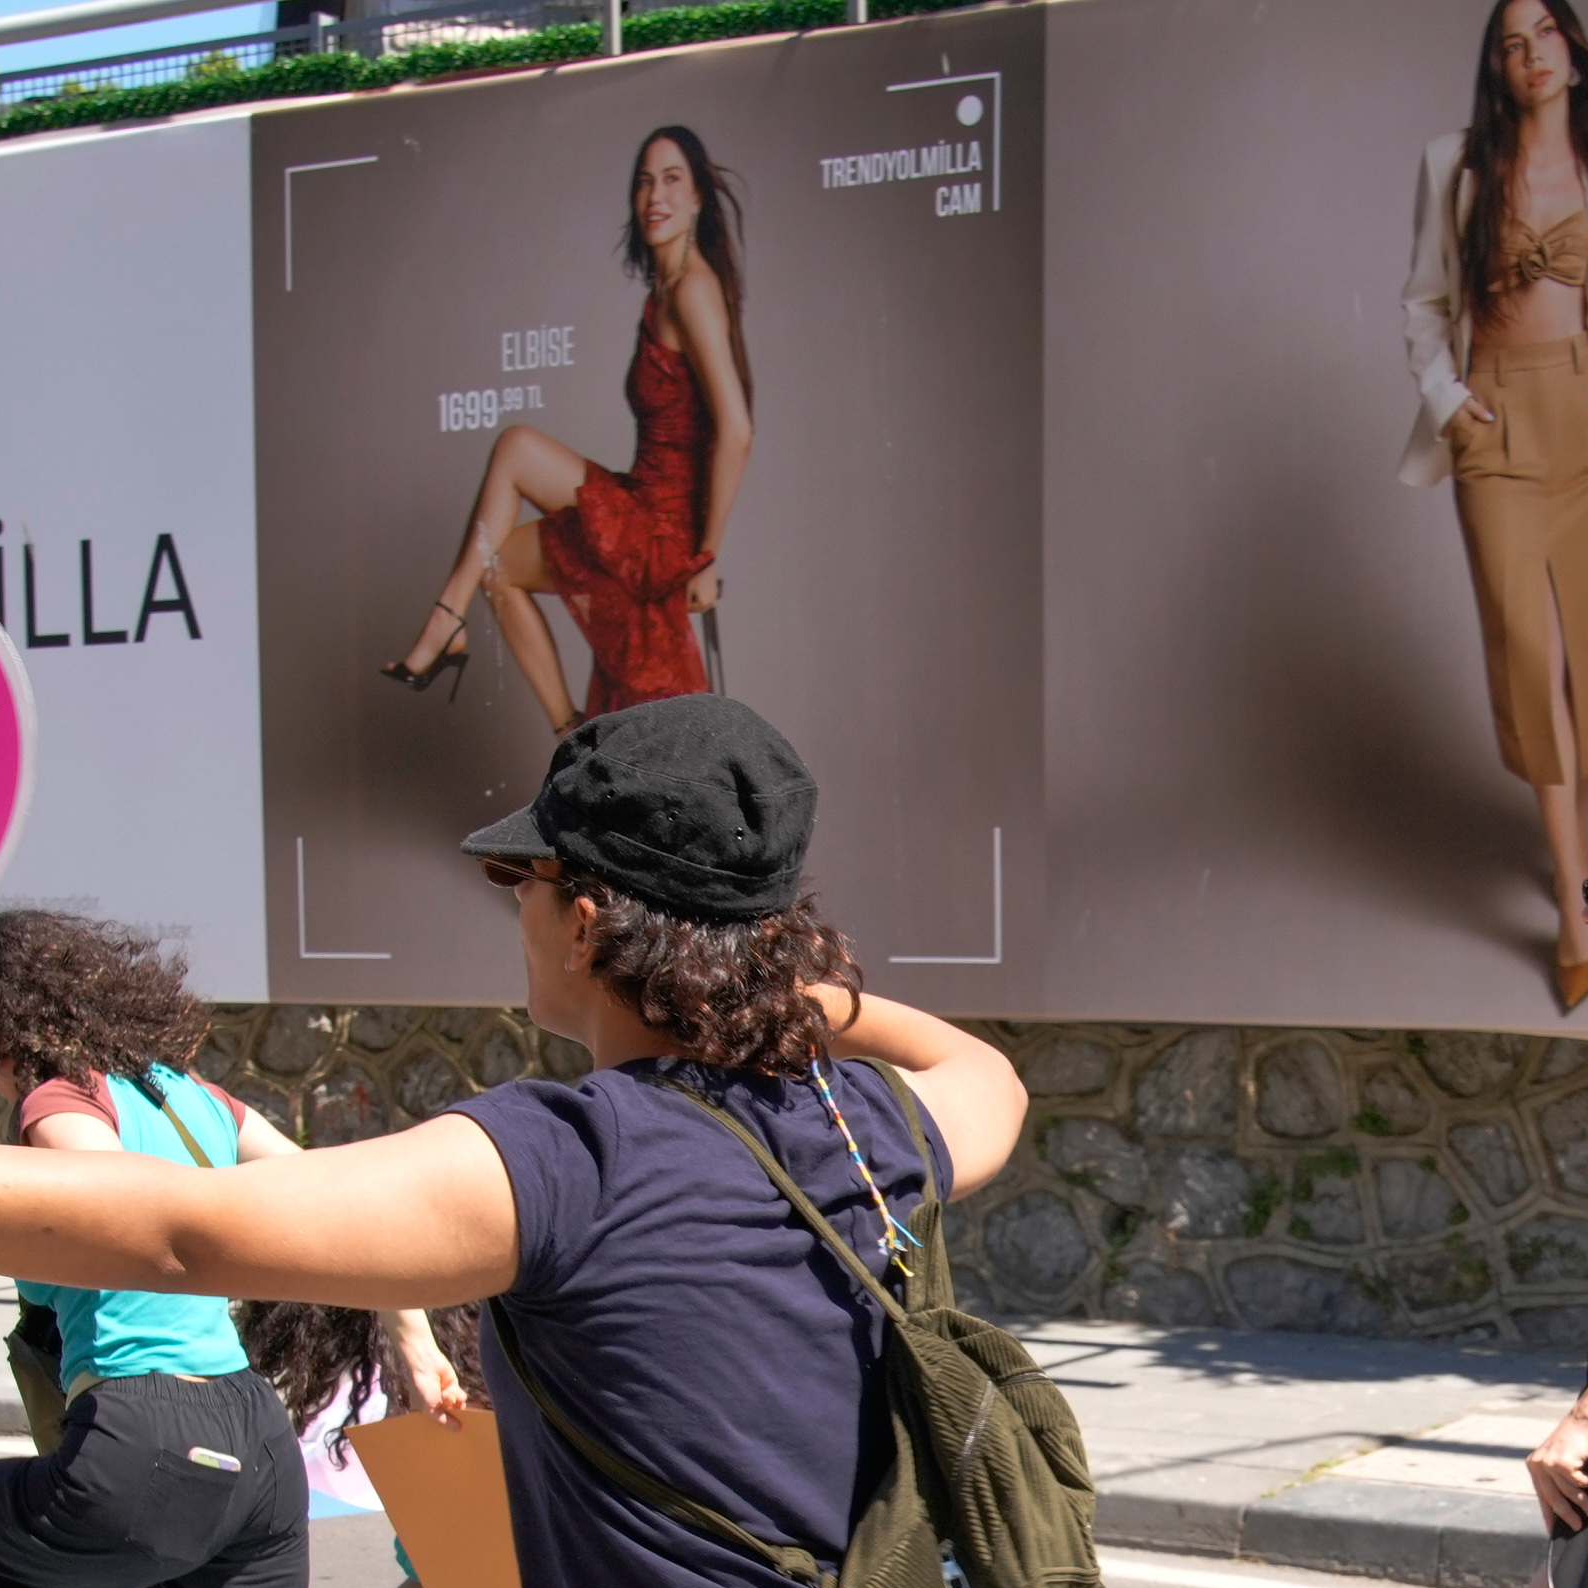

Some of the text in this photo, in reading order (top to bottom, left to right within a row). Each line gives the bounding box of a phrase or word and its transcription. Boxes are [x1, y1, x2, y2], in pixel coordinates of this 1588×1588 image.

[820, 139, 982, 189] TRENDYOLMİLLA
[935, 183, 983, 217] CAM
[501, 324, 575, 372] ELBİSE
[527, 385, 545, 409] TL
